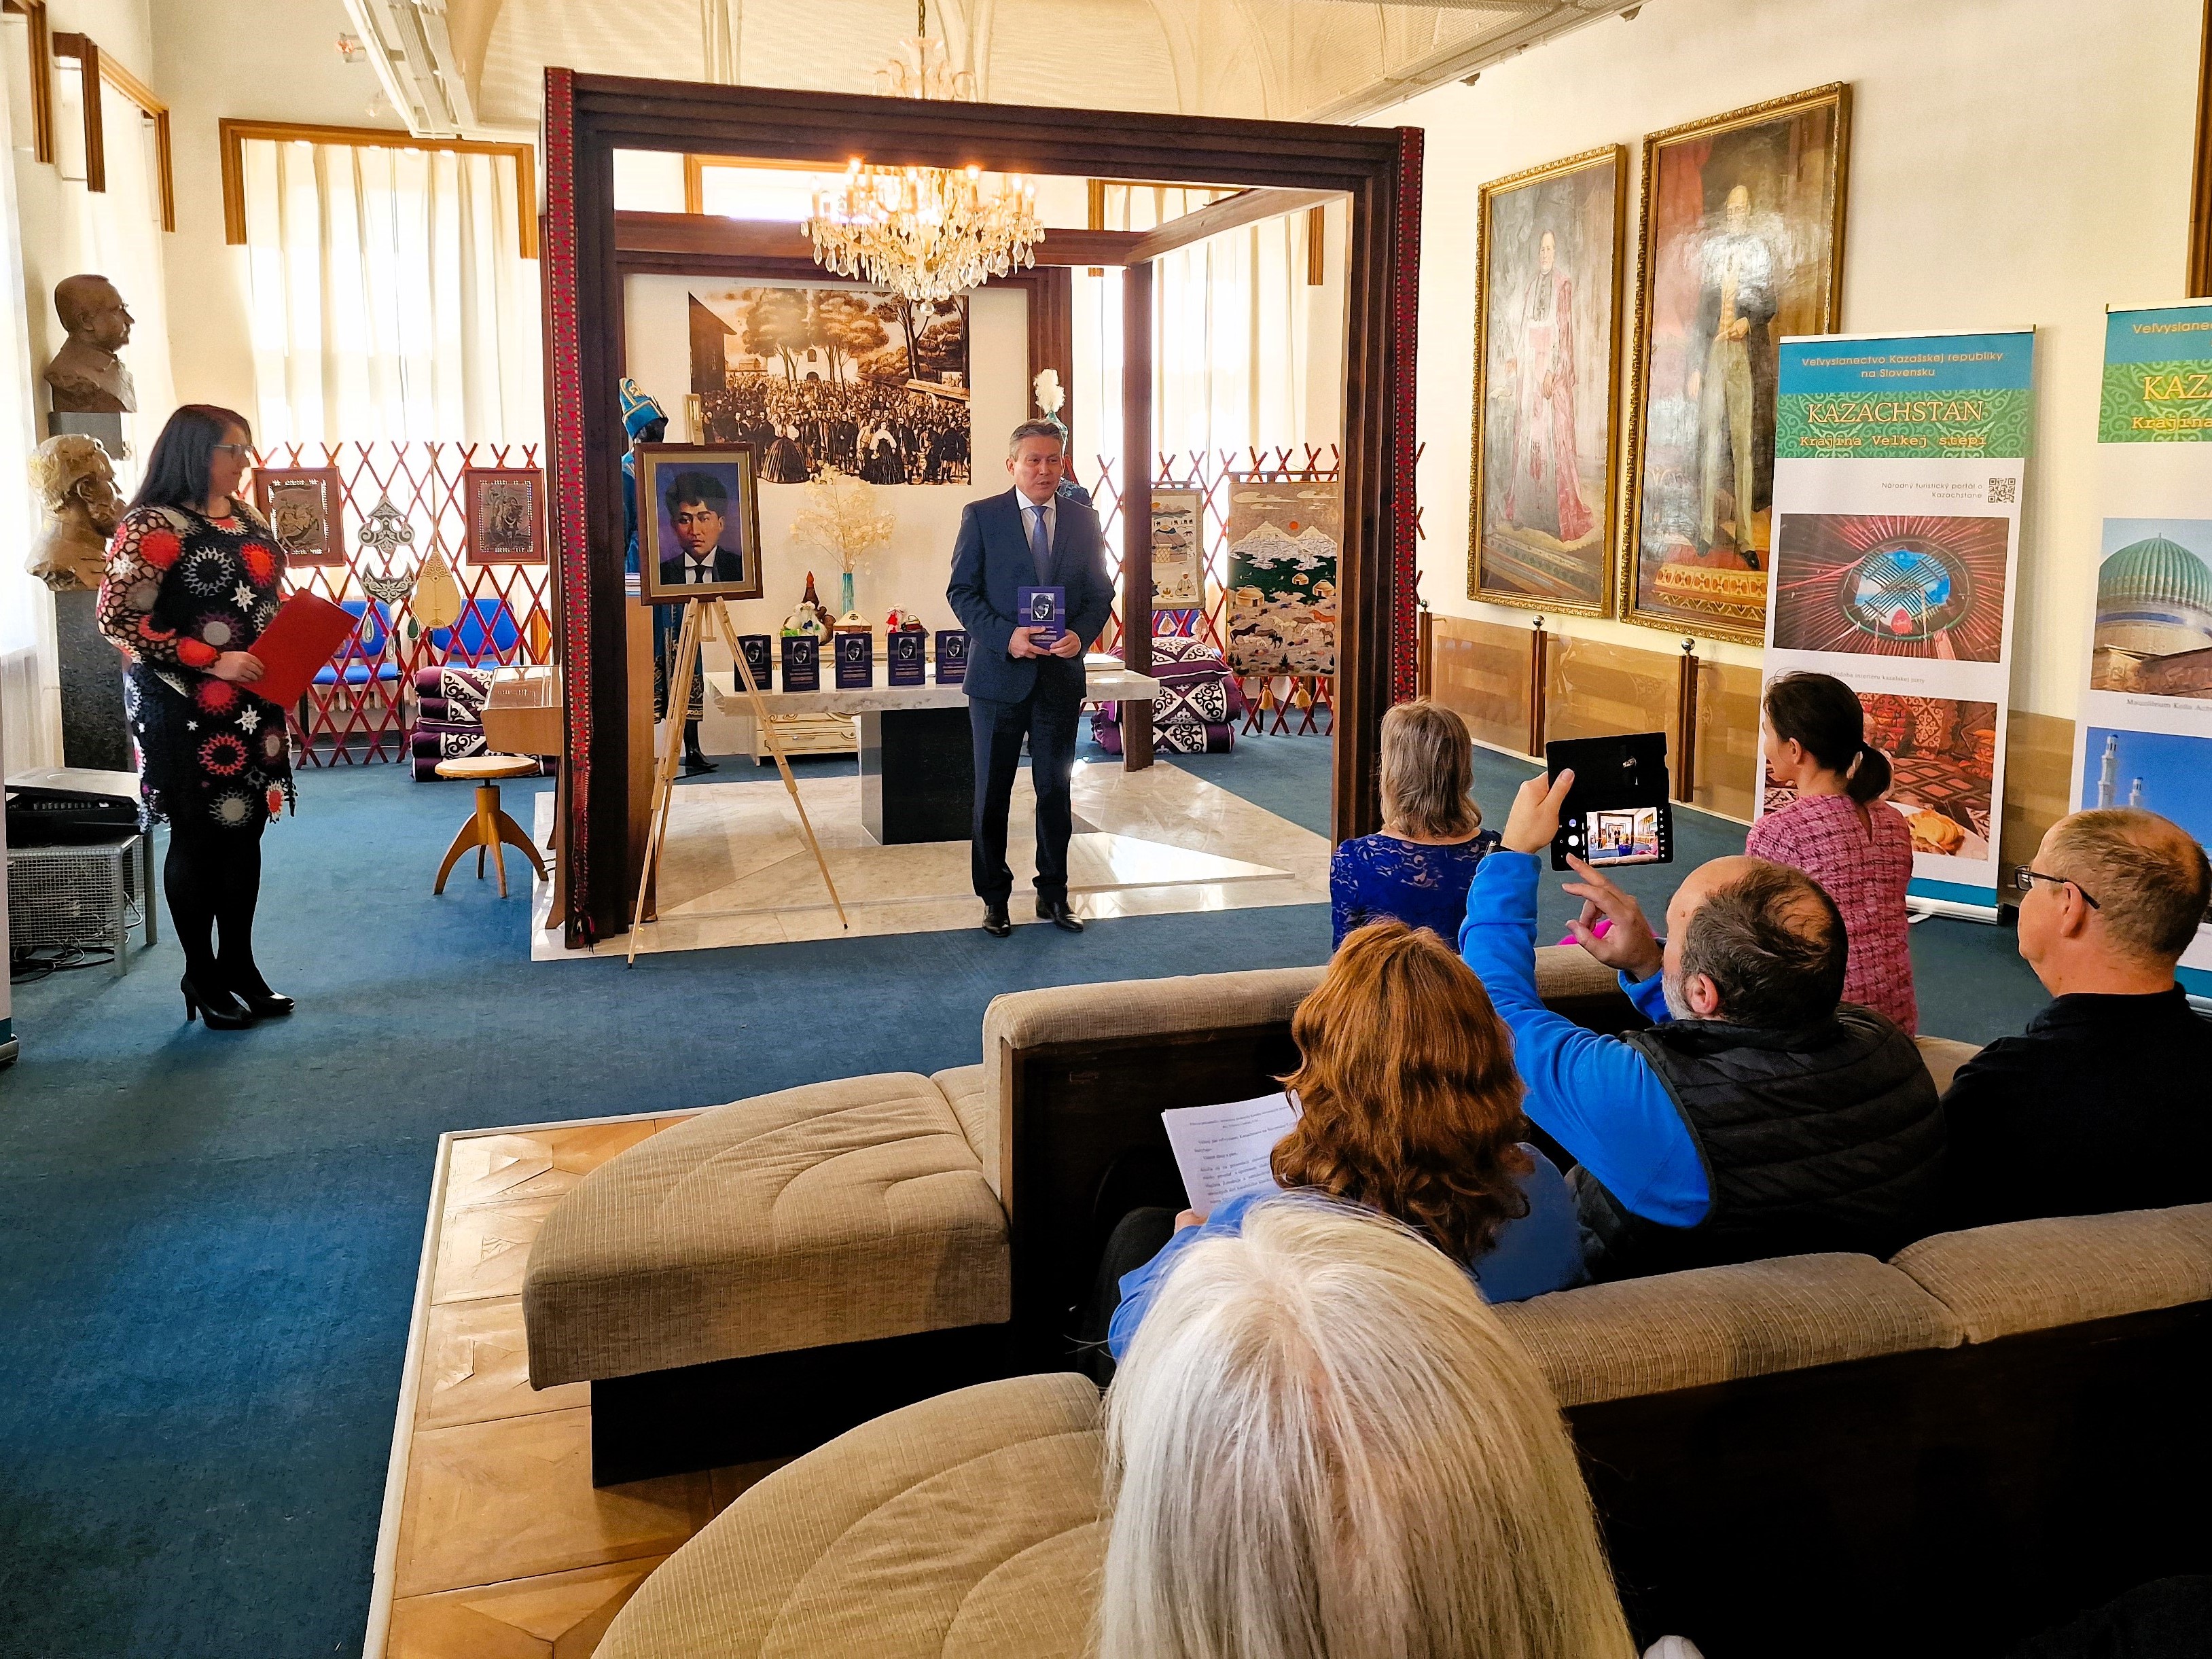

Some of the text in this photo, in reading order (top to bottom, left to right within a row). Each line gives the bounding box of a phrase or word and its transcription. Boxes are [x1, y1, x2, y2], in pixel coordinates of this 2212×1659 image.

[1948, 351, 2003, 363] republiky
[1861, 367, 1936, 378] na Slovensku
[2143, 374, 2212, 400] KAZ
[1807, 400, 1984, 423] KAZACHSTAN
[1800, 435, 1861, 448] Krajina
[1938, 434, 1986, 448] stepi
